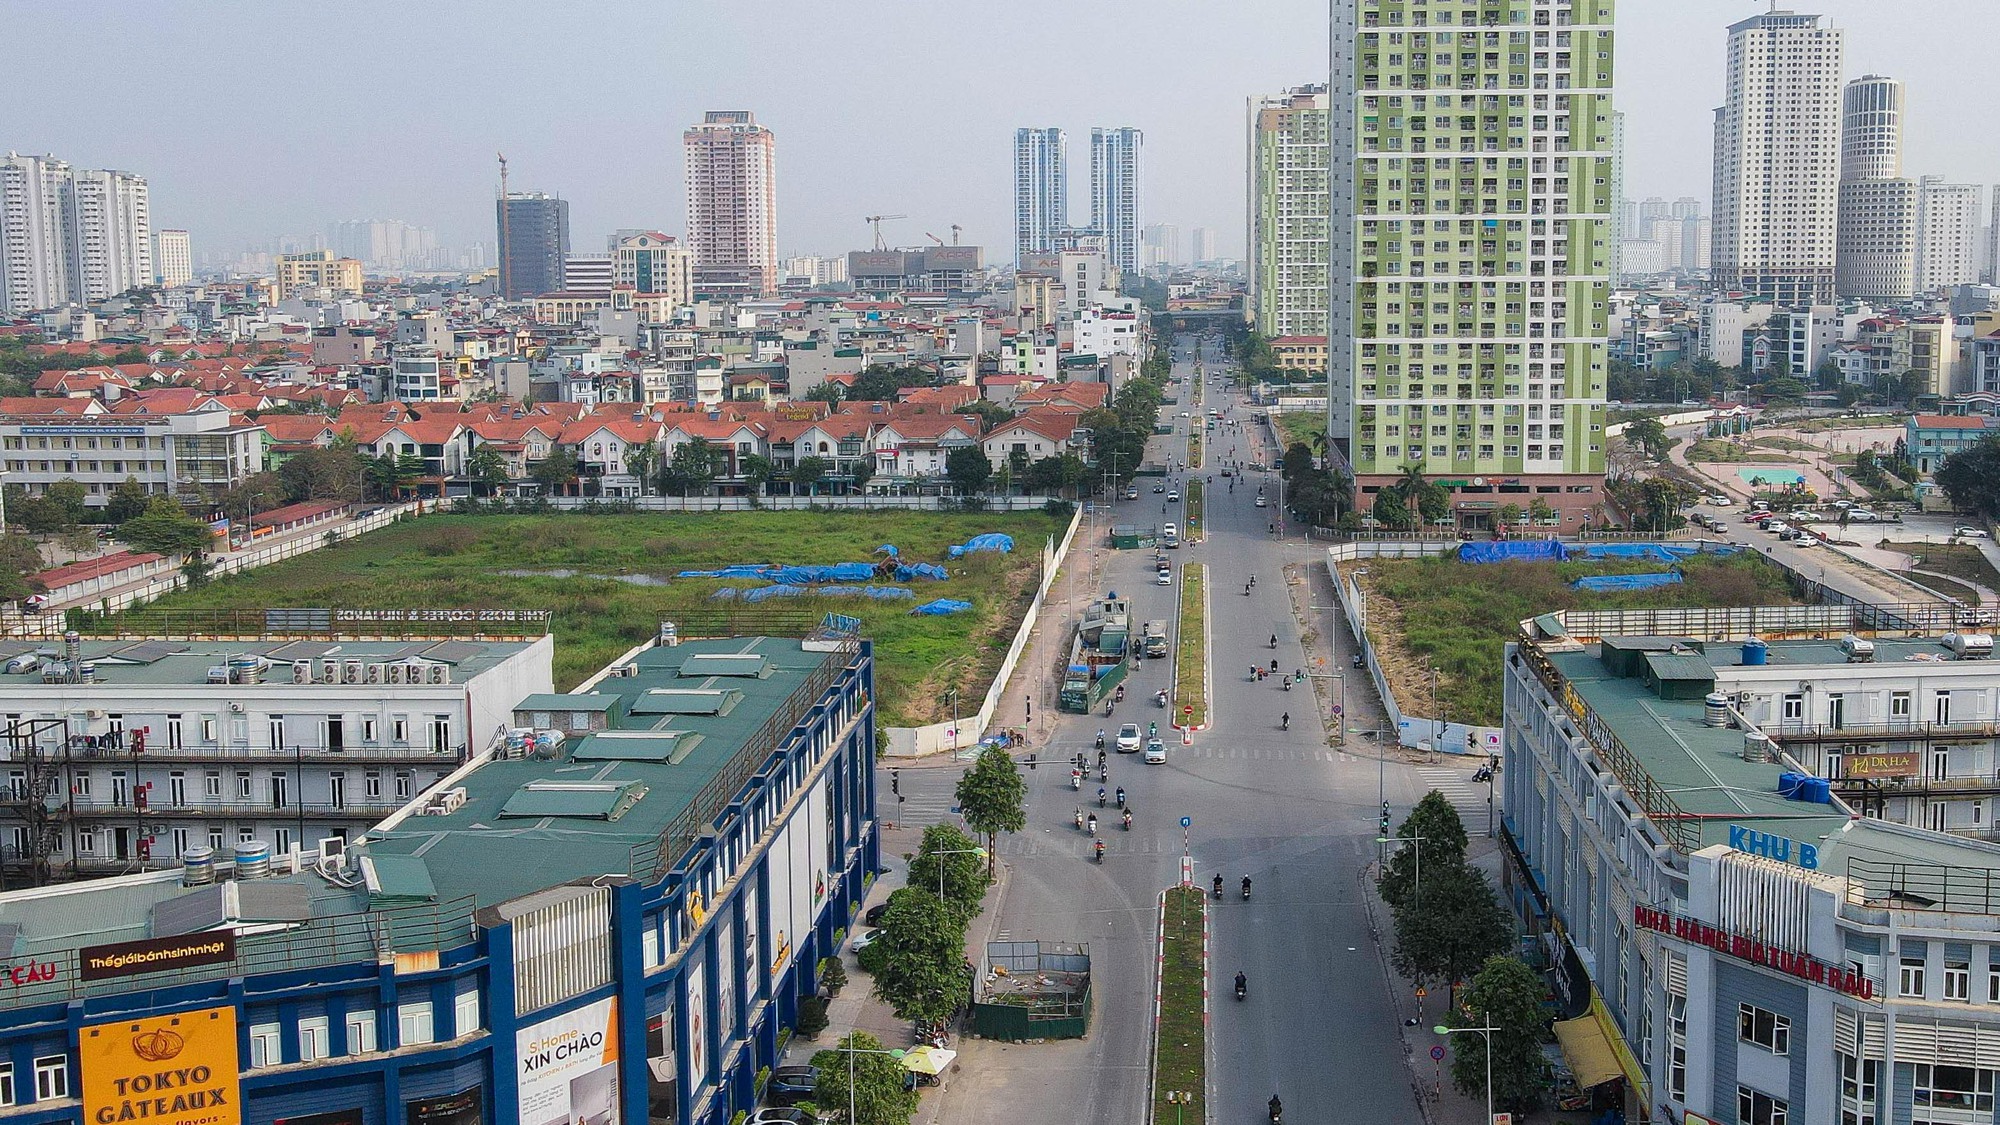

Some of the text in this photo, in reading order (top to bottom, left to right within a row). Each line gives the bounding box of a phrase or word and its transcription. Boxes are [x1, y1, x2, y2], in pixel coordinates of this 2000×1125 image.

[1729, 824, 1819, 870] KHU B
[1732, 934, 1767, 965] BIA
[524, 1050, 551, 1074] XIN
[555, 1031, 603, 1060] CHÀO
[529, 1029, 579, 1054] S.Home
[113, 1065, 212, 1097] TOKYO
[96, 1087, 228, 1124] GÂTEAUX
